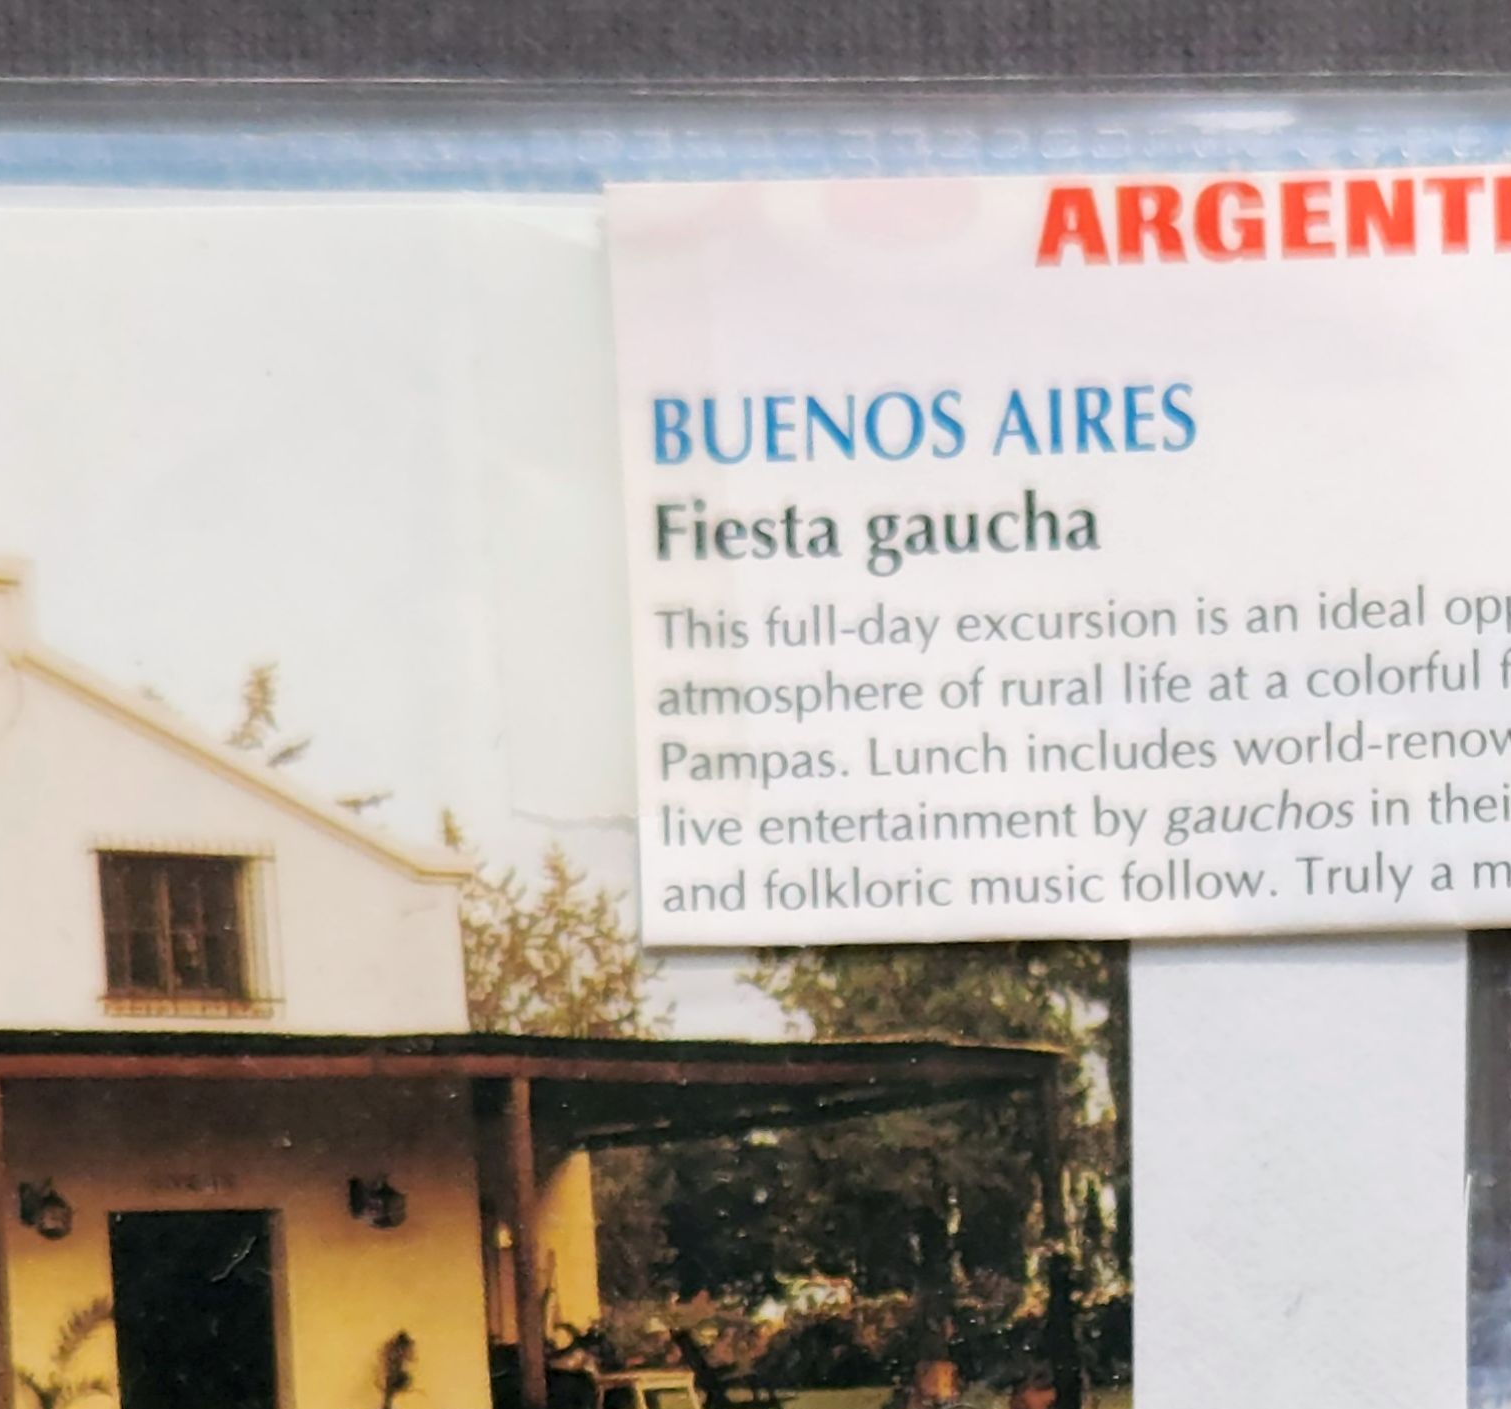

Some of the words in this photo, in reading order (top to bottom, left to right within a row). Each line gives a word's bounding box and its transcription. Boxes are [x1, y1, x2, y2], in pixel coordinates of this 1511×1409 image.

[651, 389, 966, 465] BUENOS
[993, 382, 1197, 456] AIRES
[654, 497, 842, 561] Fiesta
[866, 487, 1101, 577] gaucha
[655, 608, 749, 648] This
[765, 603, 940, 653] full-day
[956, 599, 1176, 642] excursion
[1197, 597, 1228, 635] is
[1246, 604, 1298, 633] an
[1319, 584, 1424, 630] ideal
[658, 670, 923, 723] atmosphere
[940, 666, 985, 709] of
[1002, 662, 1102, 706] rural
[1124, 661, 1191, 703] life
[1209, 666, 1249, 701] at
[1265, 670, 1288, 699] a
[1306, 648, 1479, 697] colorful
[661, 742, 849, 789] Pampas.
[869, 731, 1006, 776] Lunch
[1028, 727, 1217, 772] includes
[663, 805, 742, 845] live
[759, 802, 1076, 844] entertainment
[1093, 795, 1147, 846] by
[1164, 788, 1354, 846] gauchos
[1372, 788, 1409, 826] in
[664, 869, 745, 910] and
[764, 866, 950, 909] folkloric
[971, 864, 1102, 903] music
[1121, 858, 1279, 900] follow.
[1296, 851, 1413, 902] Truly
[1431, 863, 1453, 890] a
